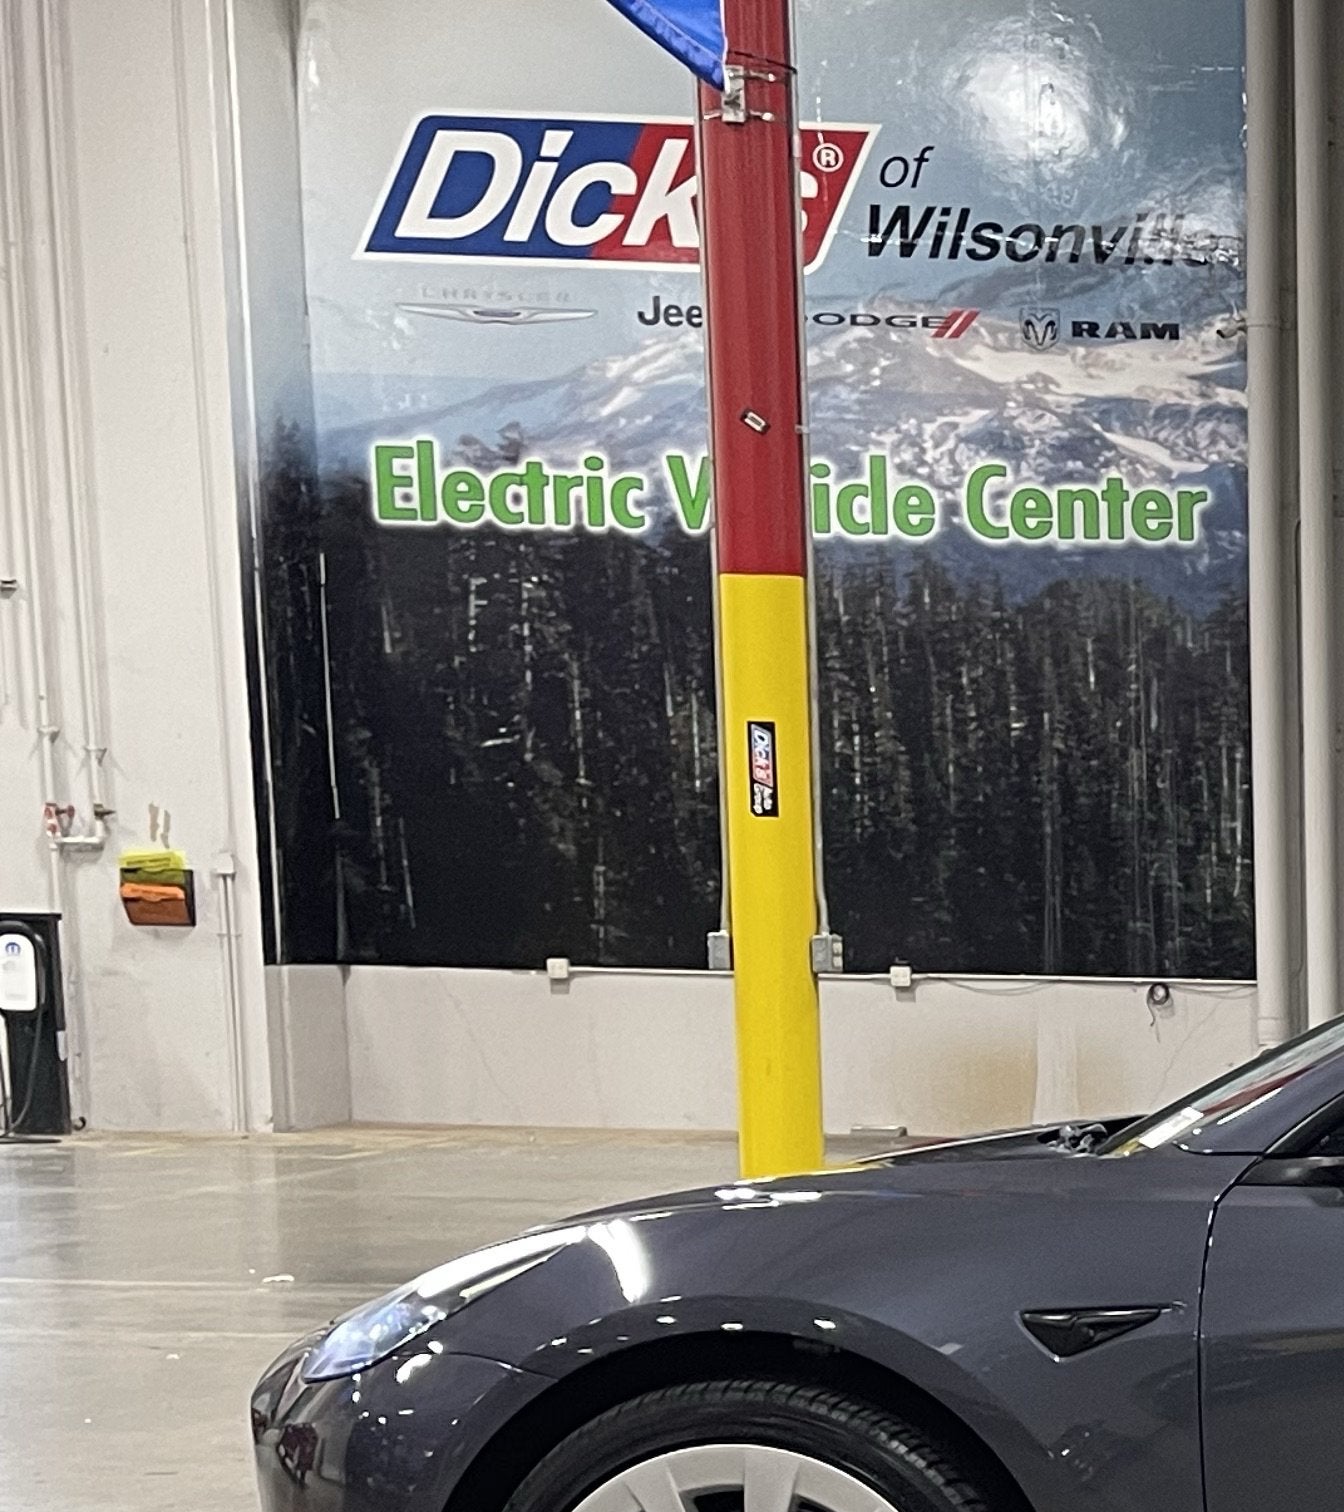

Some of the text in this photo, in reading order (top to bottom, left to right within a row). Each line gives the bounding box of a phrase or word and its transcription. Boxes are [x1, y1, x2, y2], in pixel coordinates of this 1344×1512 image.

[879, 145, 936, 189] of
[394, 129, 819, 249] Dick
[637, 295, 703, 328] Jee
[804, 312, 955, 330] ODGE
[1071, 319, 1181, 341] RAM
[374, 439, 1208, 542] Electric Vicle Center
